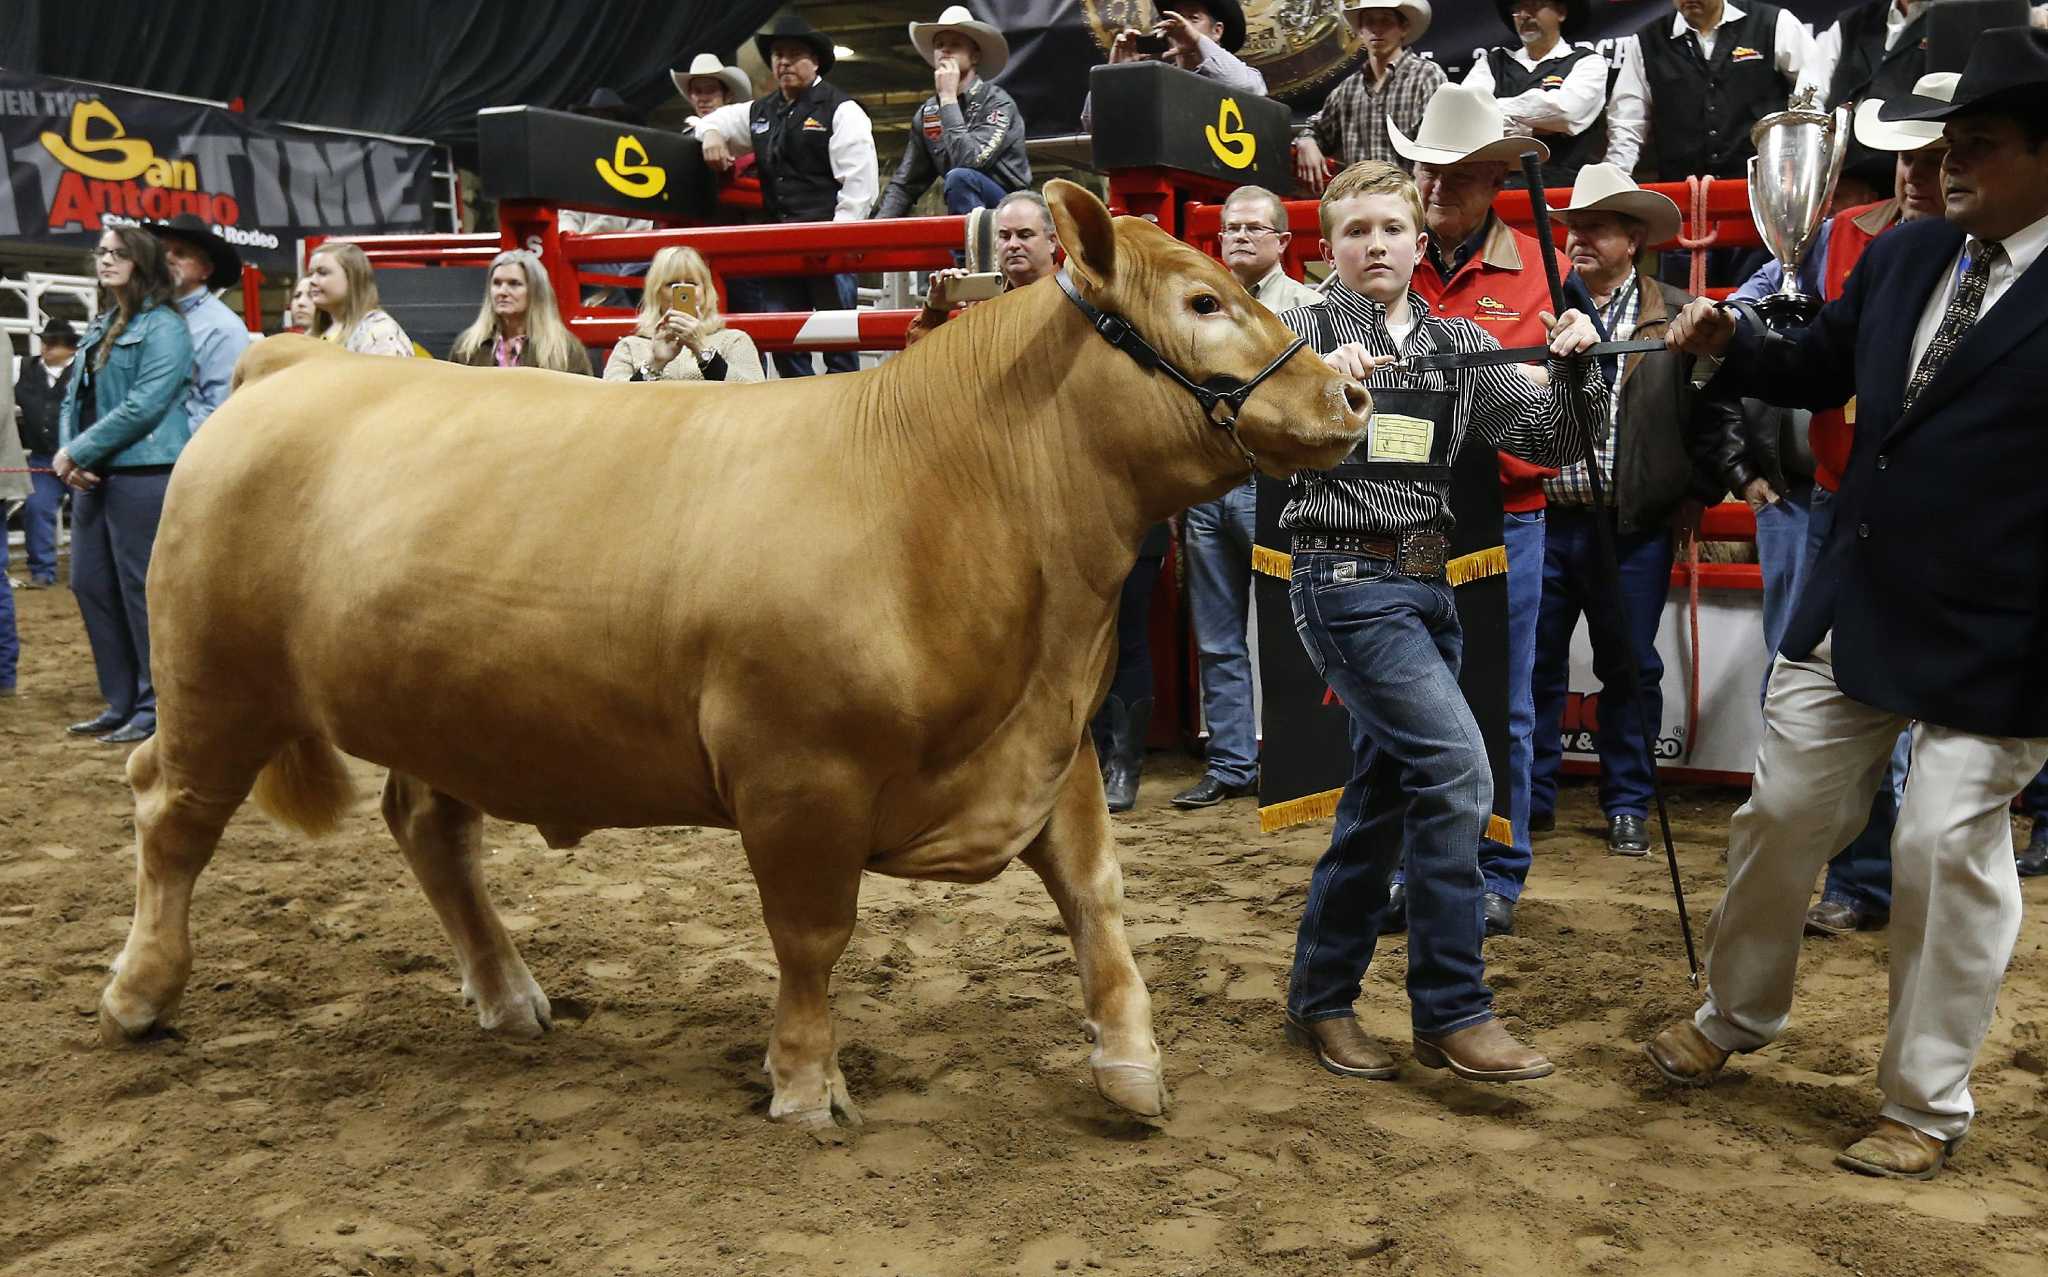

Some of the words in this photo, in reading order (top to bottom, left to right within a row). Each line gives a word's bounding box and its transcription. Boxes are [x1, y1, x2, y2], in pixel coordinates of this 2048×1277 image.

[47, 169, 241, 232] Antonio
[178, 134, 424, 227] TIME
[223, 224, 280, 250] Rodeo
